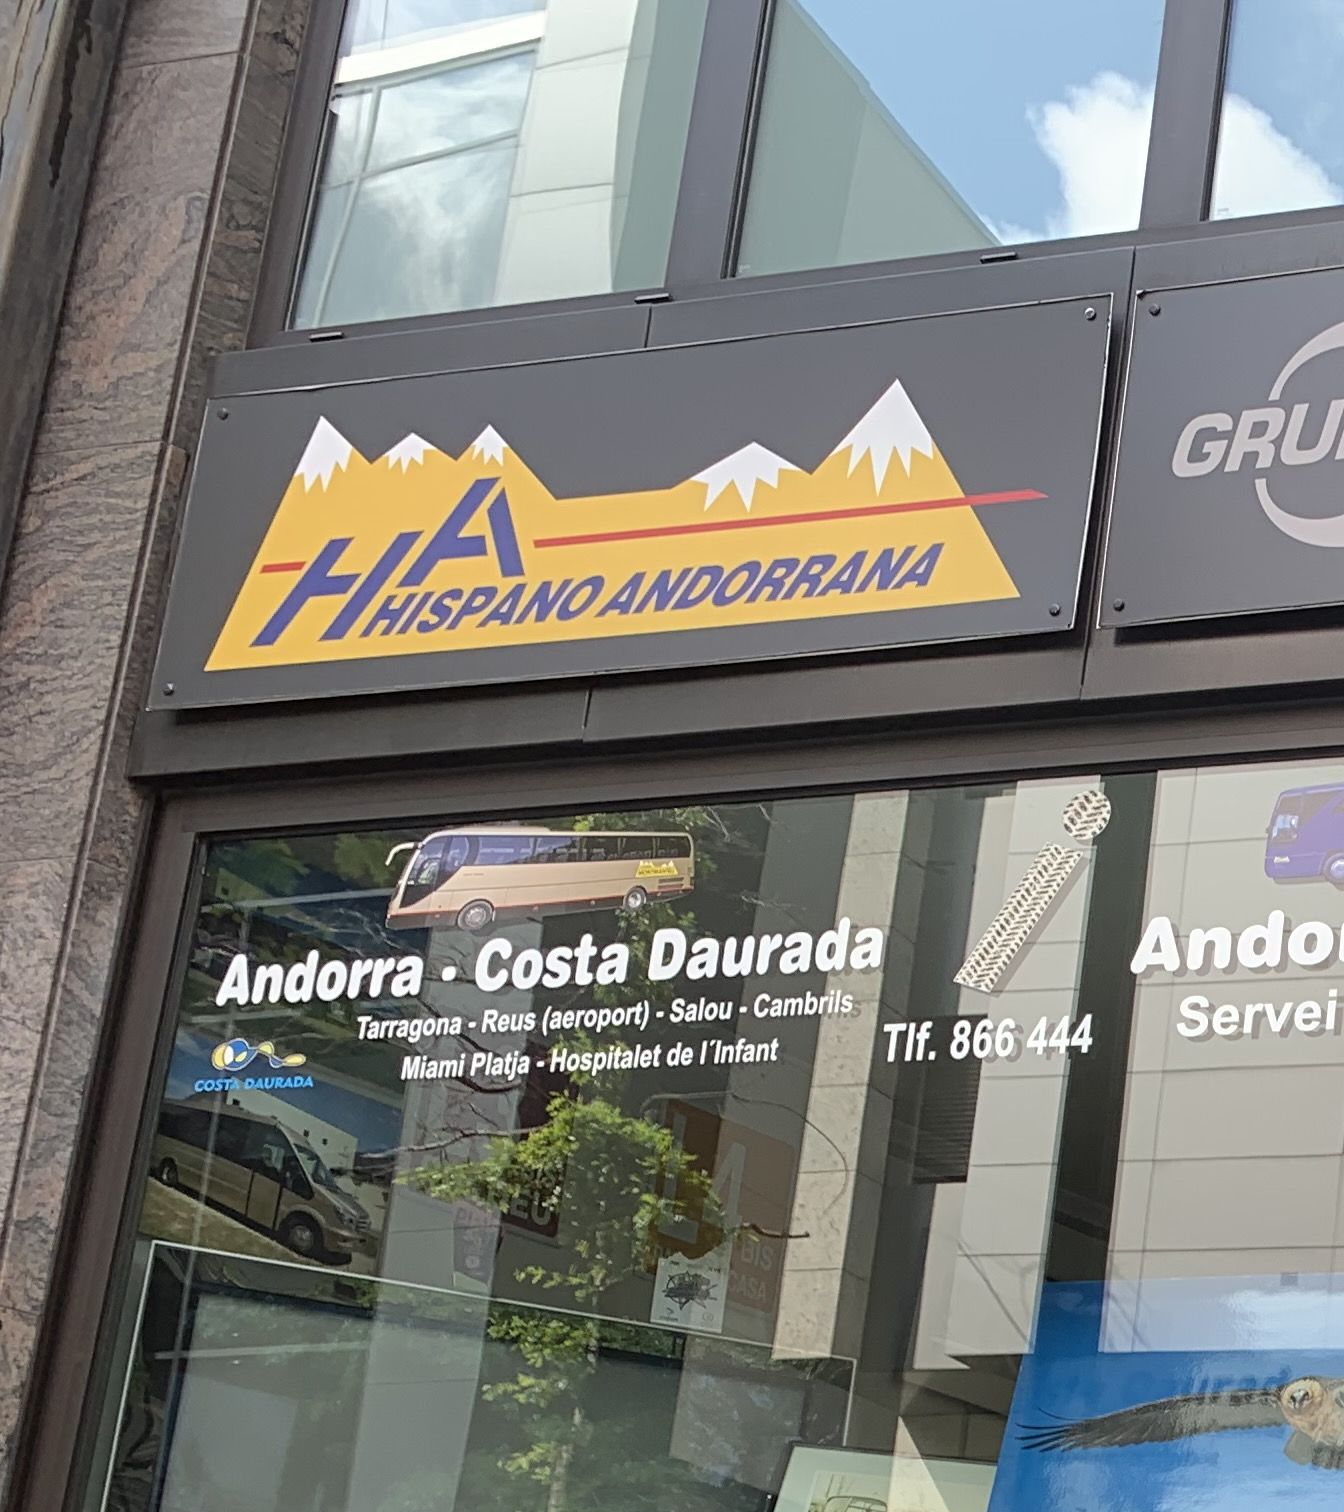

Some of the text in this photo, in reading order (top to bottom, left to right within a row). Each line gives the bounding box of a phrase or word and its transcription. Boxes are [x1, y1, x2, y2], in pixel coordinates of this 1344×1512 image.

[361, 542, 947, 639] HISPANO ANDORRANA
[215, 946, 425, 1006] Andorra
[474, 932, 629, 992] Costa
[648, 916, 885, 980] Daurada
[356, 1013, 464, 1043] Tarragona
[481, 1007, 536, 1034] Reus
[541, 999, 650, 1036] (aeroport)
[670, 994, 732, 1024] Salou
[753, 988, 855, 1020] Cambrils
[882, 1012, 1094, 1064] Tlf. 866 444
[1176, 985, 1344, 1039] Servei
[192, 1074, 314, 1092] COSTA DAURADA
[400, 1052, 468, 1081] Miami
[469, 1049, 531, 1083] Platja
[549, 1044, 662, 1077] Hospitalet
[666, 1042, 695, 1067] de
